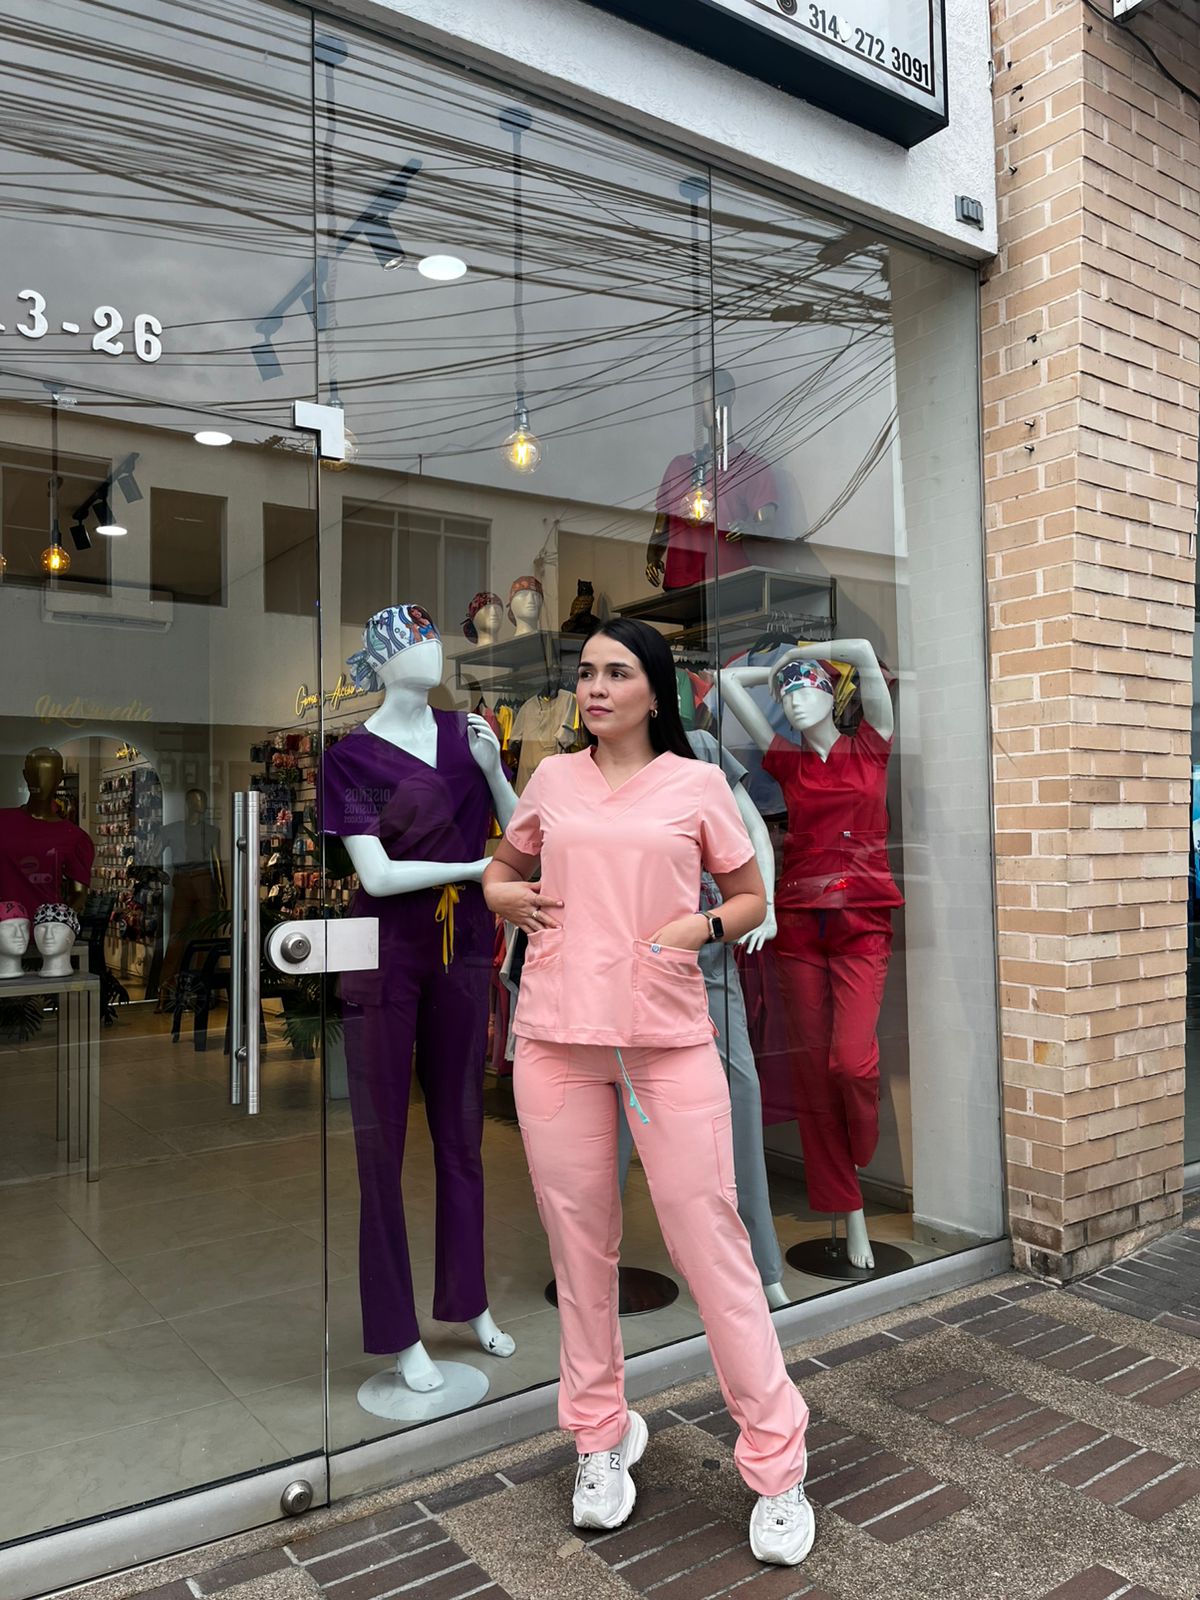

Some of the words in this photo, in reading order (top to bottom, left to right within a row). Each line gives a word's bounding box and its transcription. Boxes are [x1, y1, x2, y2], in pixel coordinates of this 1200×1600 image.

[855, 28, 885, 63] 272
[891, 47, 929, 86] 3091
[0, 289, 162, 363] 3-26
